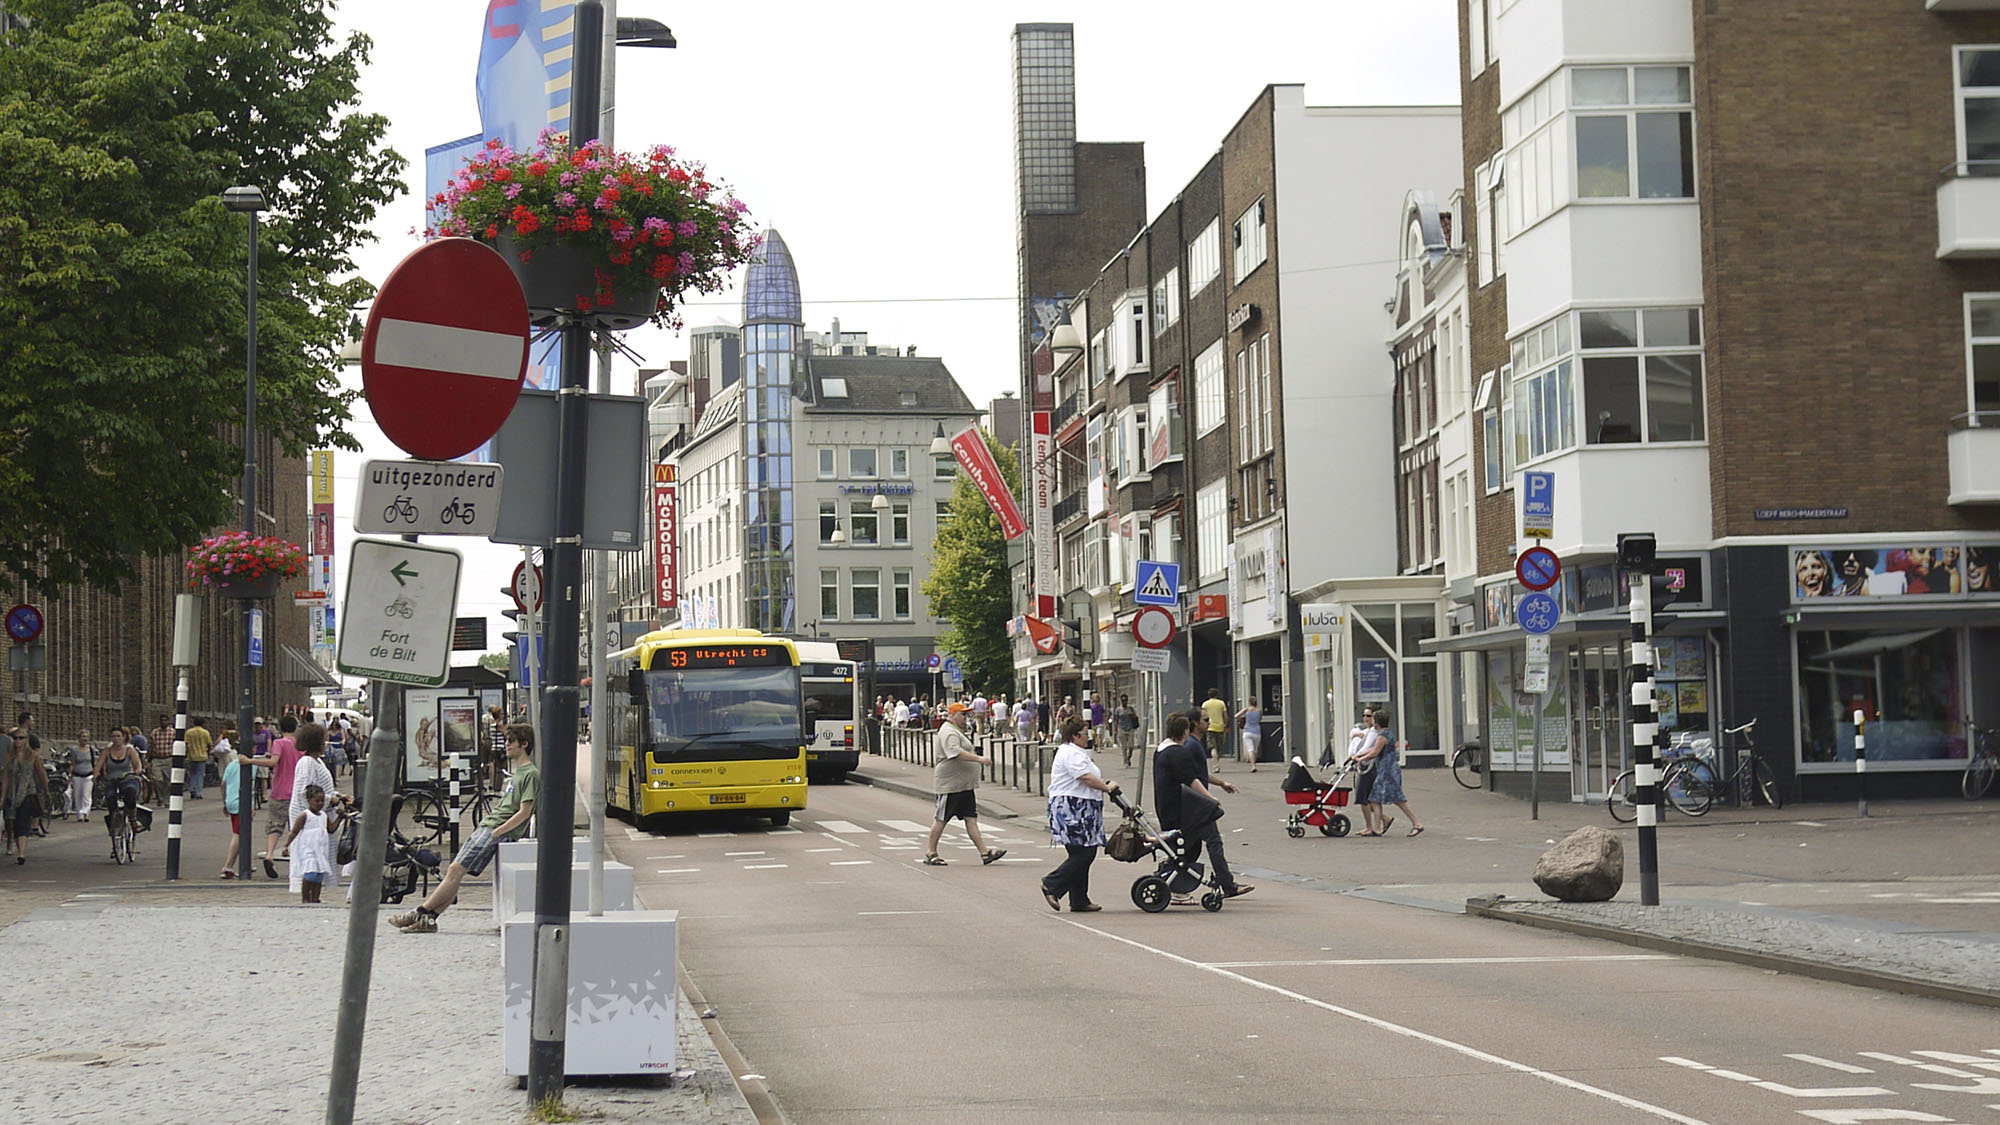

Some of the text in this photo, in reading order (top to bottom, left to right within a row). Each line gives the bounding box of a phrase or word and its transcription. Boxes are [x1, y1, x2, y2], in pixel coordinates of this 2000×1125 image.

[372, 467, 496, 490] uitgezonderd
[1036, 439, 1048, 508] tempo-team
[1530, 475, 1547, 498] P
[657, 493, 673, 602] McDonalds
[1308, 612, 1338, 626] luba
[381, 630, 410, 645] Fort
[370, 646, 417, 662] de Bilt
[671, 651, 687, 667] 53
[696, 648, 767, 659] Utrecht CS
[350, 667, 430, 683] PROVINCIE UTRECHT
[832, 667, 848, 675] 4072
